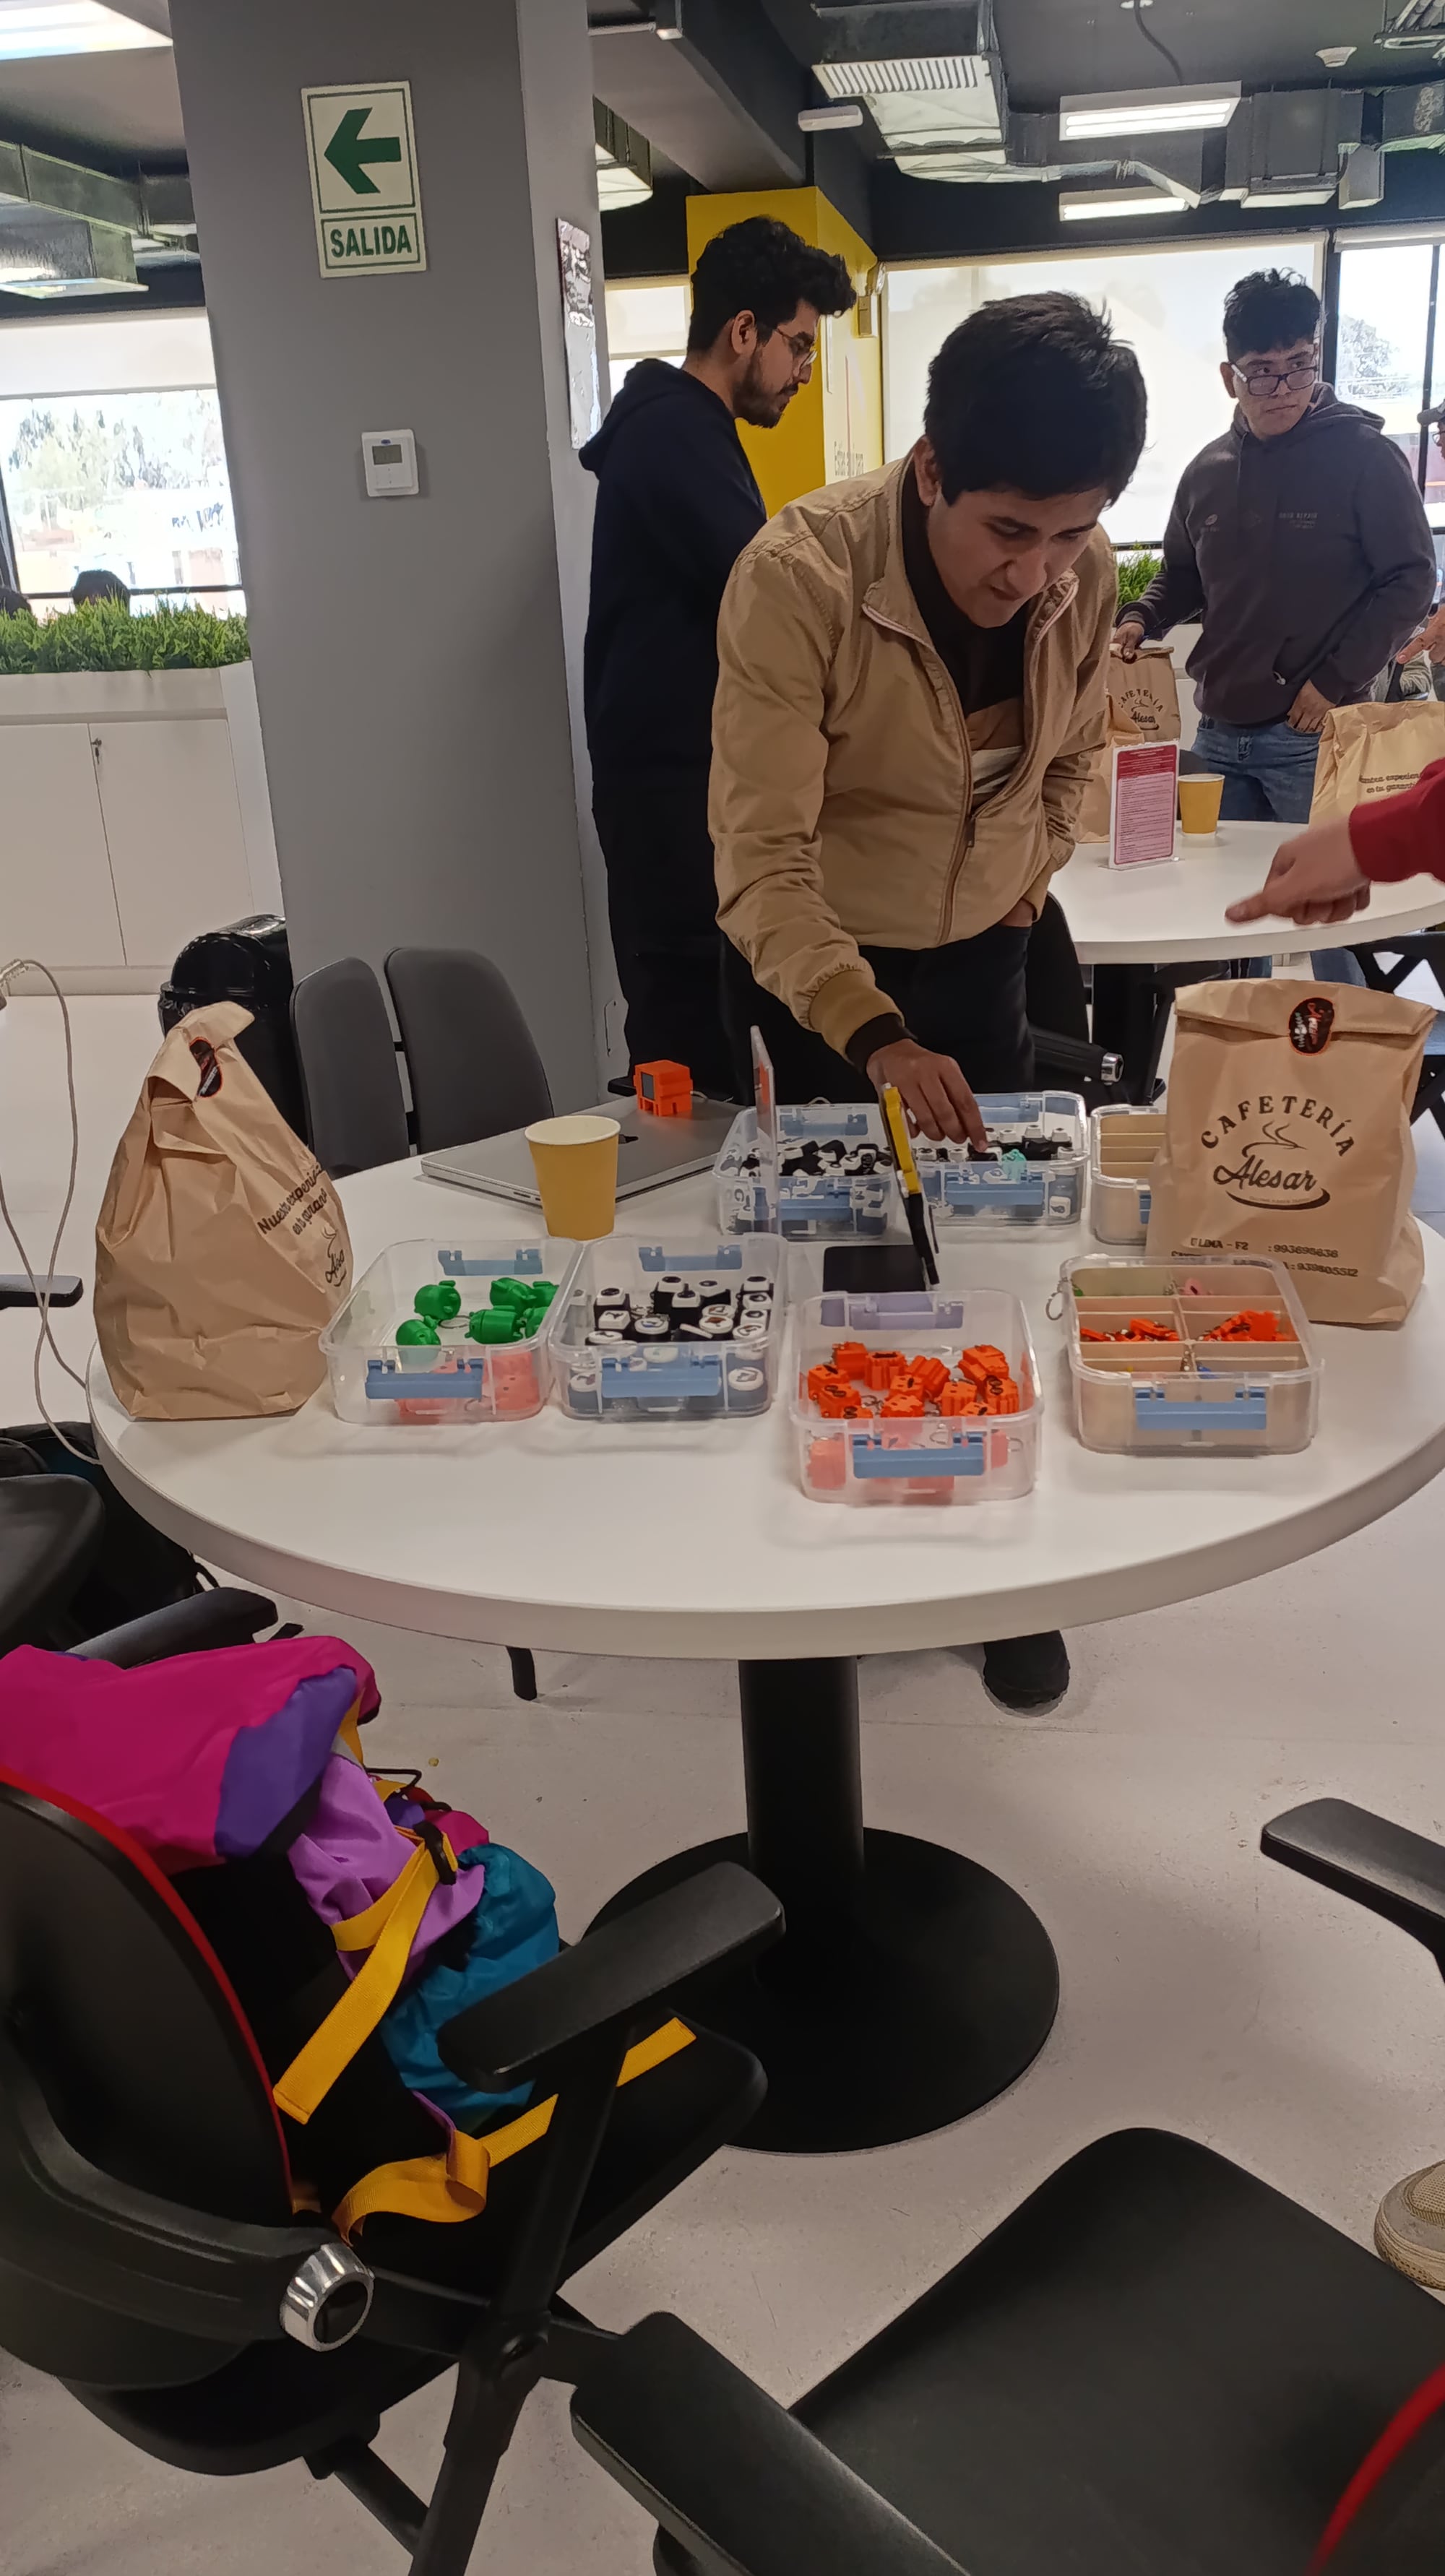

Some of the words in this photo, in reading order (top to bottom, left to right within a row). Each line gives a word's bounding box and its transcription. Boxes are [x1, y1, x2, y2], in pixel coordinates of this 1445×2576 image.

[330, 225, 412, 257] SALIDA
[1201, 1095, 1355, 1157] CAFETERÍA
[1213, 1154, 1318, 1192] Alesar
